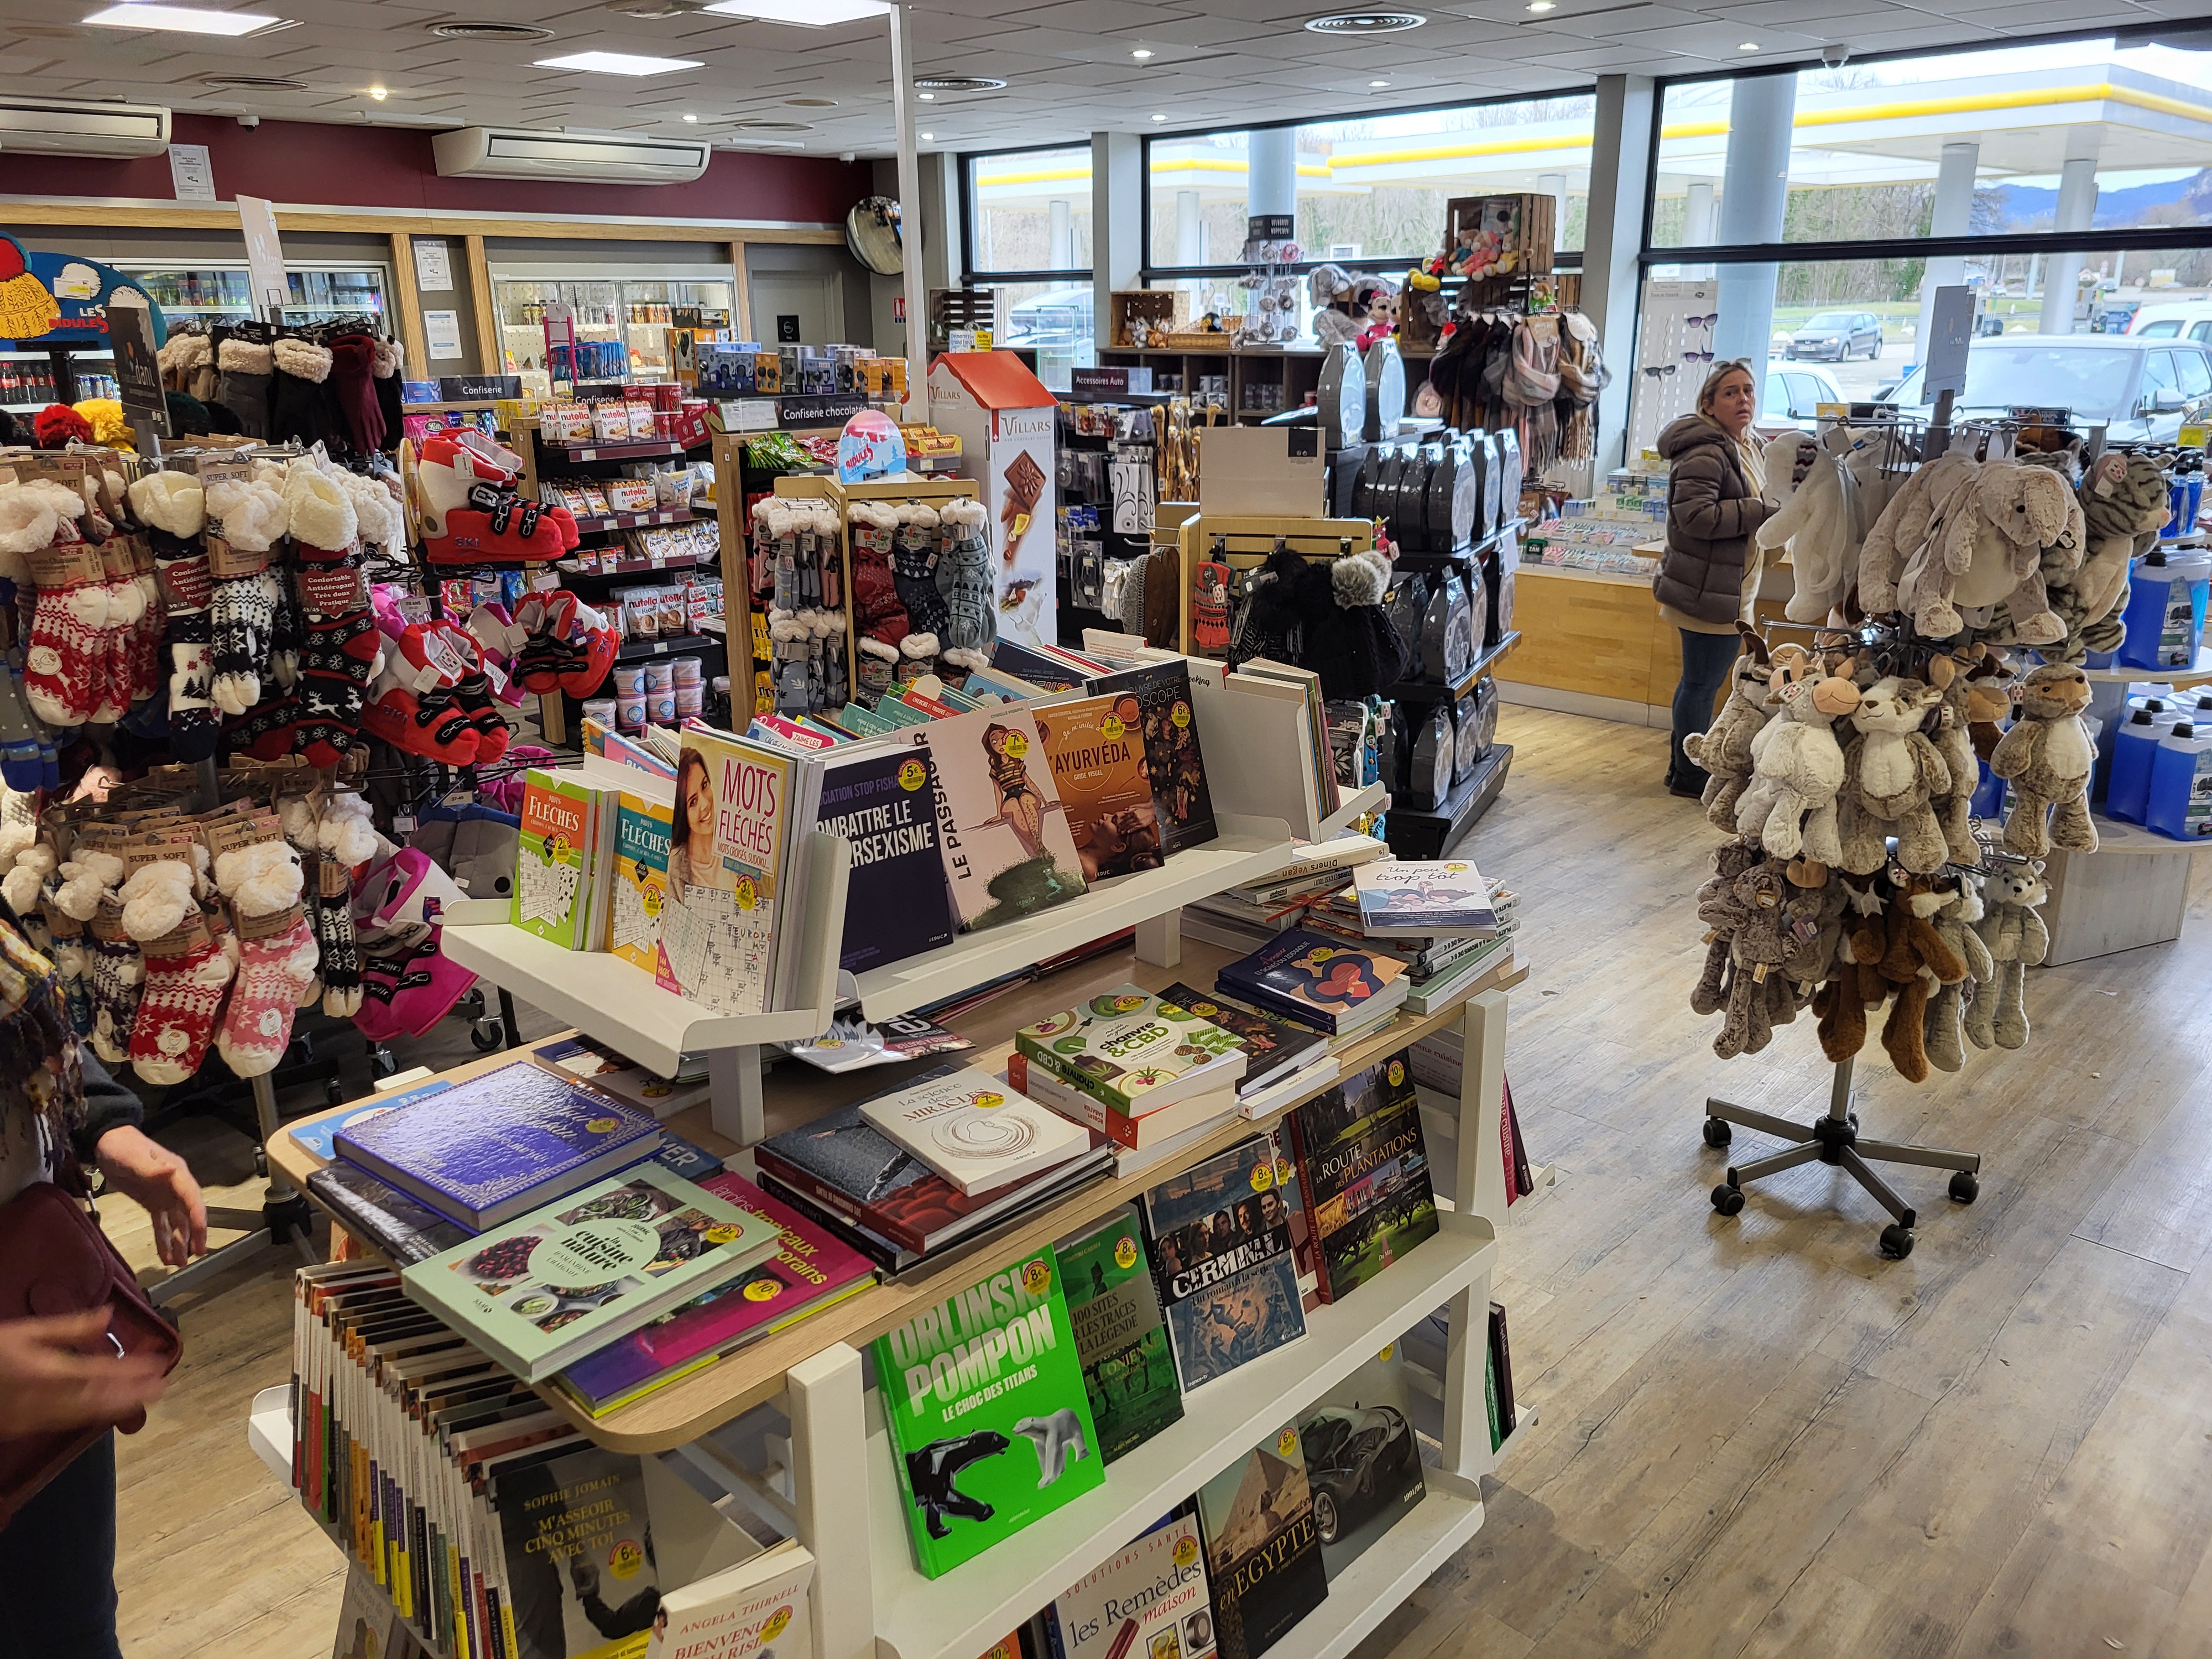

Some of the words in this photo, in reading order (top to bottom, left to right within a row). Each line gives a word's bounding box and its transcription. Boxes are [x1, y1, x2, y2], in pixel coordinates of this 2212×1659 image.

[79, 304, 106, 318] LES
[1076, 375, 1108, 385] Accessoires
[1110, 377, 1123, 385] Auto
[463, 386, 502, 395] Confiserie
[575, 396, 615, 405] Confiserie
[561, 411, 589, 421] nutella
[602, 410, 626, 419] nutella
[630, 409, 652, 418] nutella
[784, 408, 824, 420] Confiserie
[857, 431, 871, 449] LES
[846, 445, 873, 471] BIDULES
[207, 473, 227, 482] SUPER
[621, 488, 647, 497] nutella
[306, 581, 355, 592] Antidérapant
[307, 574, 351, 583] Confortable
[319, 598, 349, 607] Pratique
[628, 597, 657, 609] nutella
[660, 593, 684, 603] utella
[1136, 682, 1152, 693] LIVRE
[1161, 676, 1181, 686] VOTRE
[912, 697, 928, 707] CHERCHE
[1138, 686, 1182, 709] OSCOPE
[1177, 706, 1186, 715] 6€
[1108, 717, 1117, 727] 7€
[793, 734, 808, 744] J'AIME
[809, 737, 819, 747] LES
[1011, 735, 1020, 745] 7€
[1050, 741, 1130, 775] 'AYURVÉDA
[906, 765, 918, 777] 5€
[1073, 771, 1087, 780] GUIDE
[1088, 769, 1103, 778] VISUEL
[722, 759, 778, 817] MOTS
[854, 780, 874, 796] STOP
[815, 805, 890, 839] OMBATTRE
[896, 799, 912, 826] LE
[719, 809, 773, 854] FLÉCHÉS
[1373, 820, 1385, 838] INTER
[221, 839, 249, 852] SUPER
[254, 833, 276, 844] SOFT
[718, 842, 730, 854] MOTS
[852, 822, 934, 868] RSEXISME
[129, 853, 157, 863] SUPER
[163, 852, 186, 860] SOFT
[1311, 859, 1337, 870] Dîners
[952, 854, 972, 880] LE
[1282, 867, 1308, 877] Vegan
[1376, 873, 1420, 884] trop
[1427, 870, 1458, 880] tôt
[928, 934, 943, 942] LEDUC
[1285, 941, 1311, 958] ZODIAQUE
[1099, 1022, 1156, 1050] chanvre
[1037, 1050, 1053, 1068] CBD
[1055, 1061, 1061, 1073] &
[1434, 1051, 1462, 1067] cuisine
[1062, 1065, 1094, 1090] chanvre
[917, 1083, 962, 1100] science
[928, 1094, 950, 1104] des
[1084, 1104, 1103, 1117] SABATIER
[1088, 1113, 1103, 1124] ROBERT
[1501, 1117, 1511, 1159] cuisine
[1316, 1175, 1323, 1184] LA
[1322, 1144, 1362, 1179] ROUTE
[1335, 1179, 1344, 1190] DES
[1343, 1127, 1417, 1183] PLANTATIONS
[1258, 1167, 1268, 1180] 8€
[1297, 1160, 1314, 1212] PLANTATIONS
[753, 1209, 818, 1256] tropicaux
[1311, 1227, 1320, 1251] ROUTE
[560, 1237, 617, 1271] nature
[576, 1230, 633, 1264] cuisine
[1122, 1242, 1131, 1254] 8€
[1314, 1251, 1321, 1260] LA
[1172, 1232, 1284, 1299] GERMINAL
[1379, 1253, 1385, 1262] Du
[1030, 1269, 1042, 1281] 8€
[1192, 1293, 1206, 1307] Du
[1206, 1280, 1234, 1300] roman
[1241, 1273, 1249, 1285] la
[1250, 1262, 1272, 1281] série
[1073, 1307, 1091, 1326] 100
[1092, 1292, 1118, 1317] SITES
[1086, 1320, 1100, 1337] LES
[1100, 1299, 1136, 1329] TRACES
[1081, 1339, 1094, 1355] LA
[1095, 1314, 1138, 1350] LÉGENDE
[905, 1303, 1056, 1417] POMPON
[942, 1405, 955, 1423] LE
[956, 1391, 983, 1419] CHOC
[983, 1380, 1003, 1402] DES
[1003, 1364, 1038, 1391] TITANS
[523, 1488, 571, 1511] SOPHIE
[575, 1473, 620, 1498] JOMAIN
[1403, 1480, 1423, 1503] 1991/92
[539, 1498, 614, 1532] M'ASSEOIR
[525, 1531, 564, 1553] CINQ
[568, 1509, 631, 1541] MINUTES
[547, 1543, 586, 1564] AVEC
[588, 1530, 614, 1550] TOI
[1066, 1550, 1139, 1599] SOLUTIONS
[1149, 1523, 1188, 1552] SANTÉ
[1220, 1587, 1236, 1611] en
[1233, 1514, 1316, 1598] EGYPTE
[680, 1610, 735, 1635] ANGELA
[742, 1584, 799, 1616] THIRKELL
[1068, 1617, 1099, 1649] les
[1103, 1561, 1202, 1627] Remèdes
[1142, 1585, 1197, 1625] maison
[675, 1619, 766, 1659] BIENVENU
